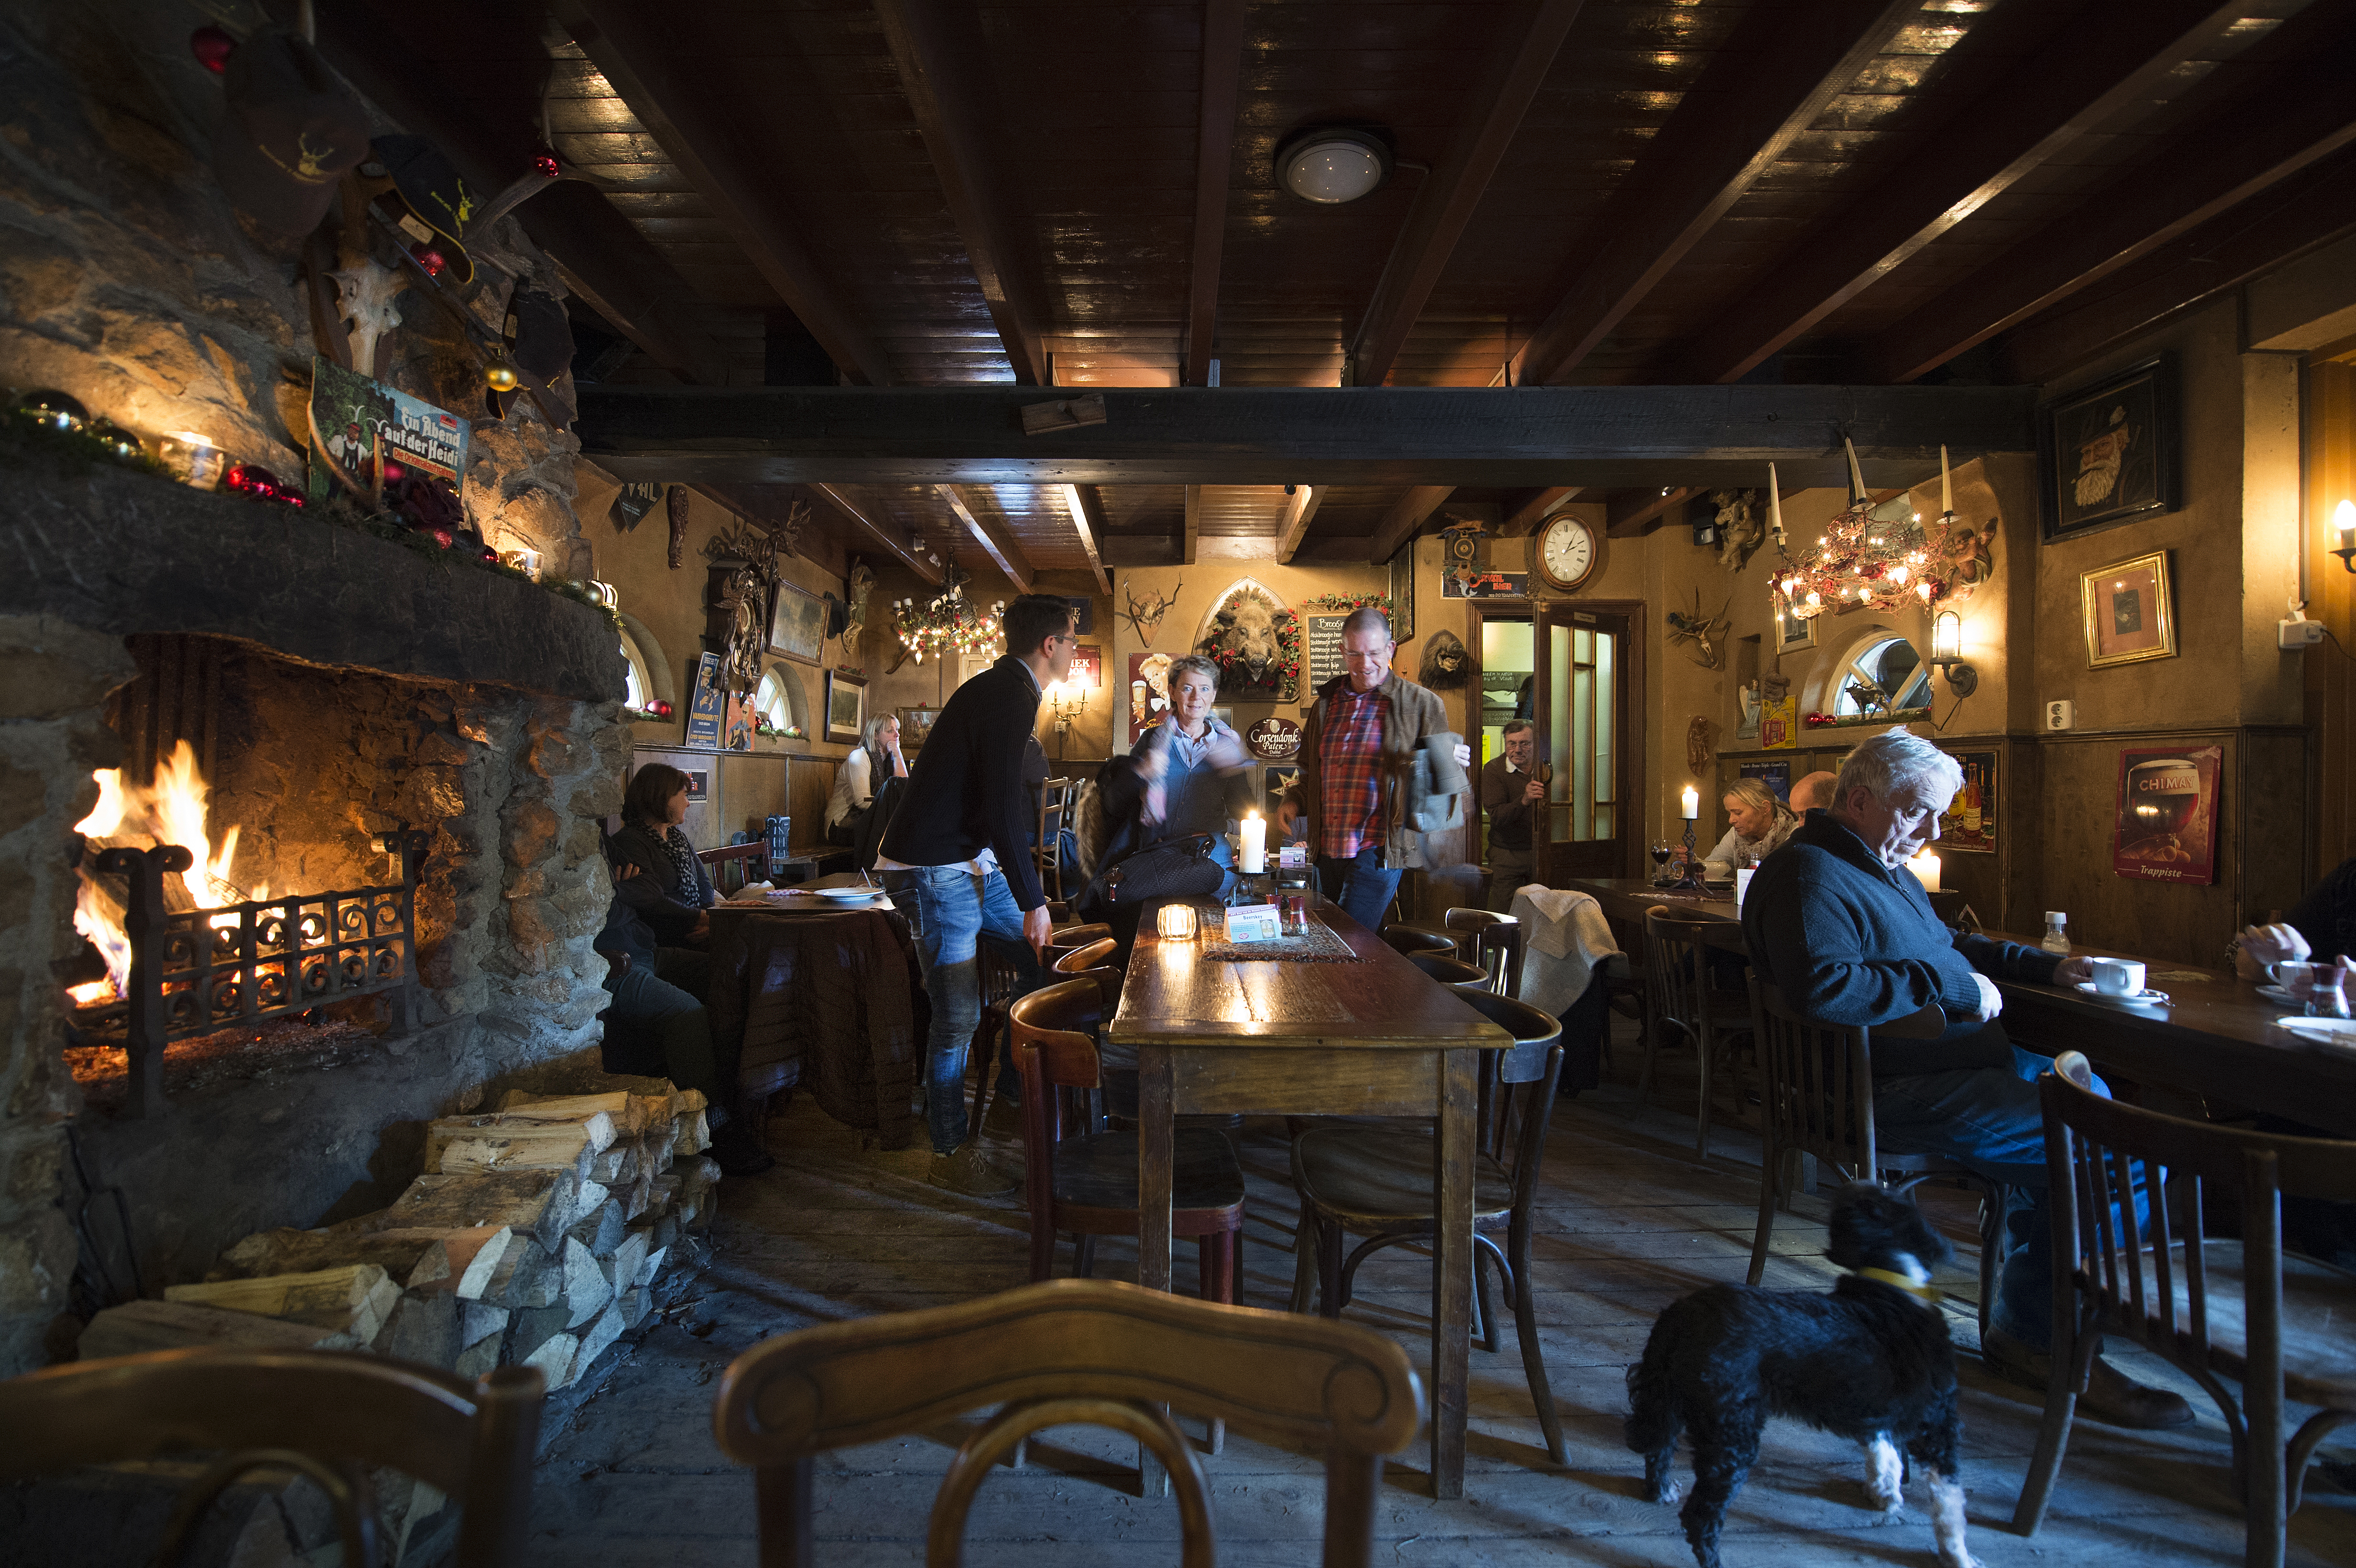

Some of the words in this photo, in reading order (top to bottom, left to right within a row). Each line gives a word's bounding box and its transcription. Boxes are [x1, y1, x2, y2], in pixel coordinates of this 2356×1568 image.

[421, 415, 460, 447] Abend
[428, 439, 458, 467] Heidi
[1251, 728, 1299, 742] Corsendonk
[2139, 776, 2194, 791] CHIMAY
[2141, 865, 2182, 878] Trappiste
